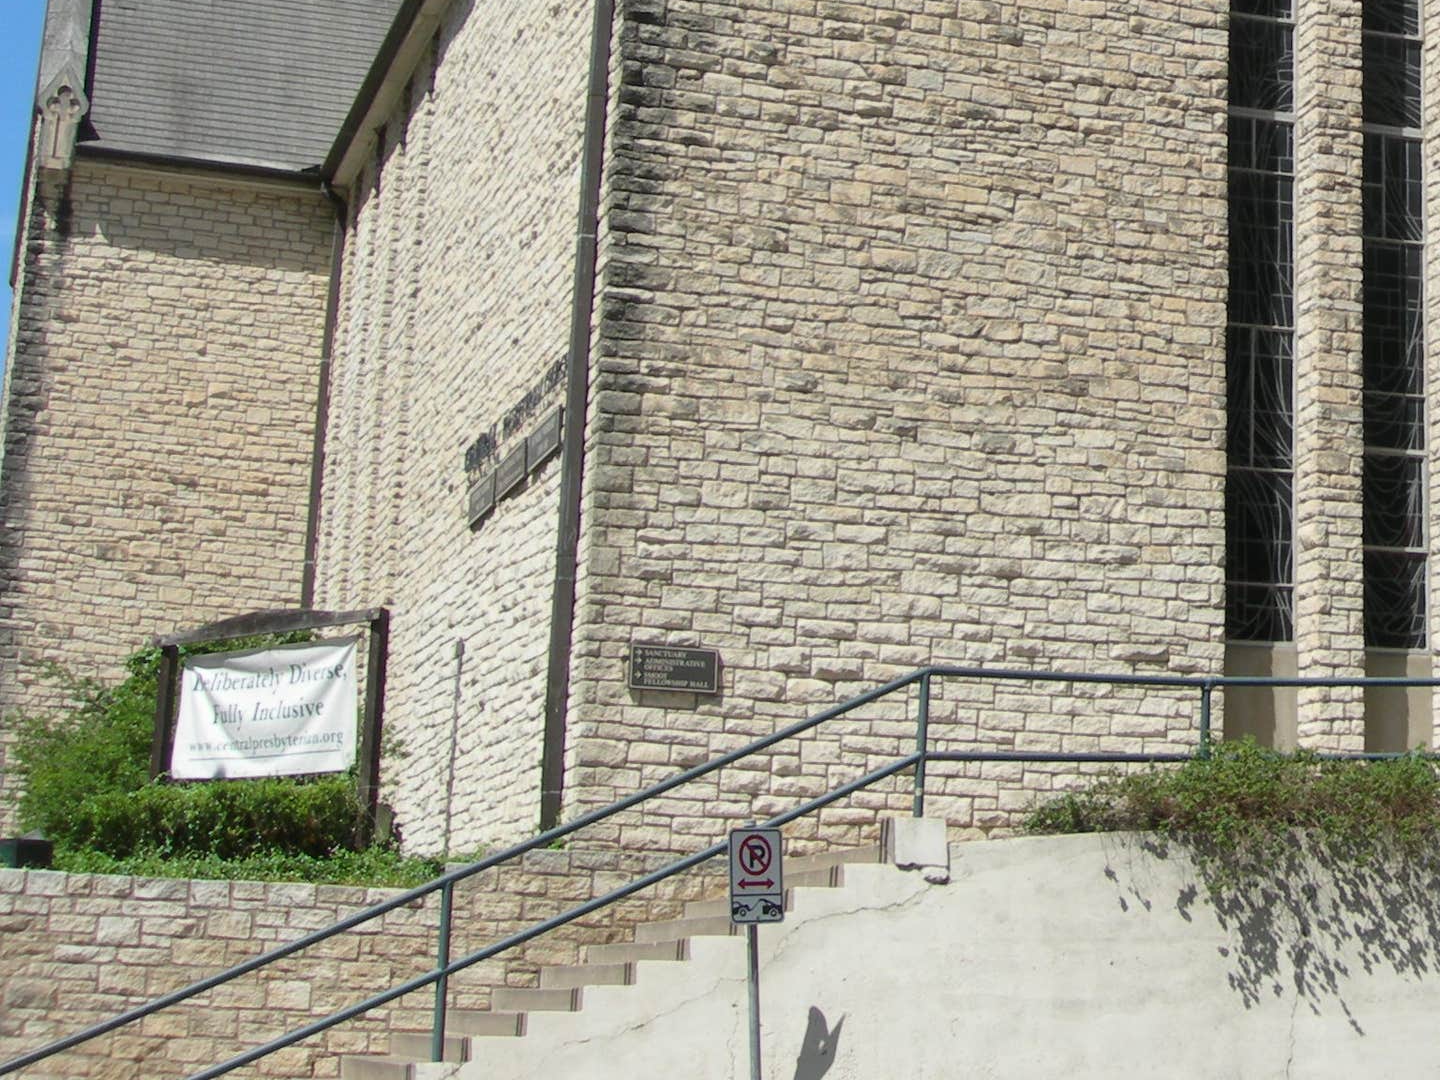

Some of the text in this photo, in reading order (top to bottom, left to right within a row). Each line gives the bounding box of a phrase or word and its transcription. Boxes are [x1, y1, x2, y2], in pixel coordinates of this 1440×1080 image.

[644, 649, 687, 658] SANCTUARY
[643, 664, 674, 672] OFFICES
[645, 658, 705, 668] ADMINISTRATIVE
[192, 662, 348, 694] Deliberately Diverse,
[643, 679, 709, 689] FELLOWSHIP HALL
[212, 698, 325, 731] Fully Inclusive
